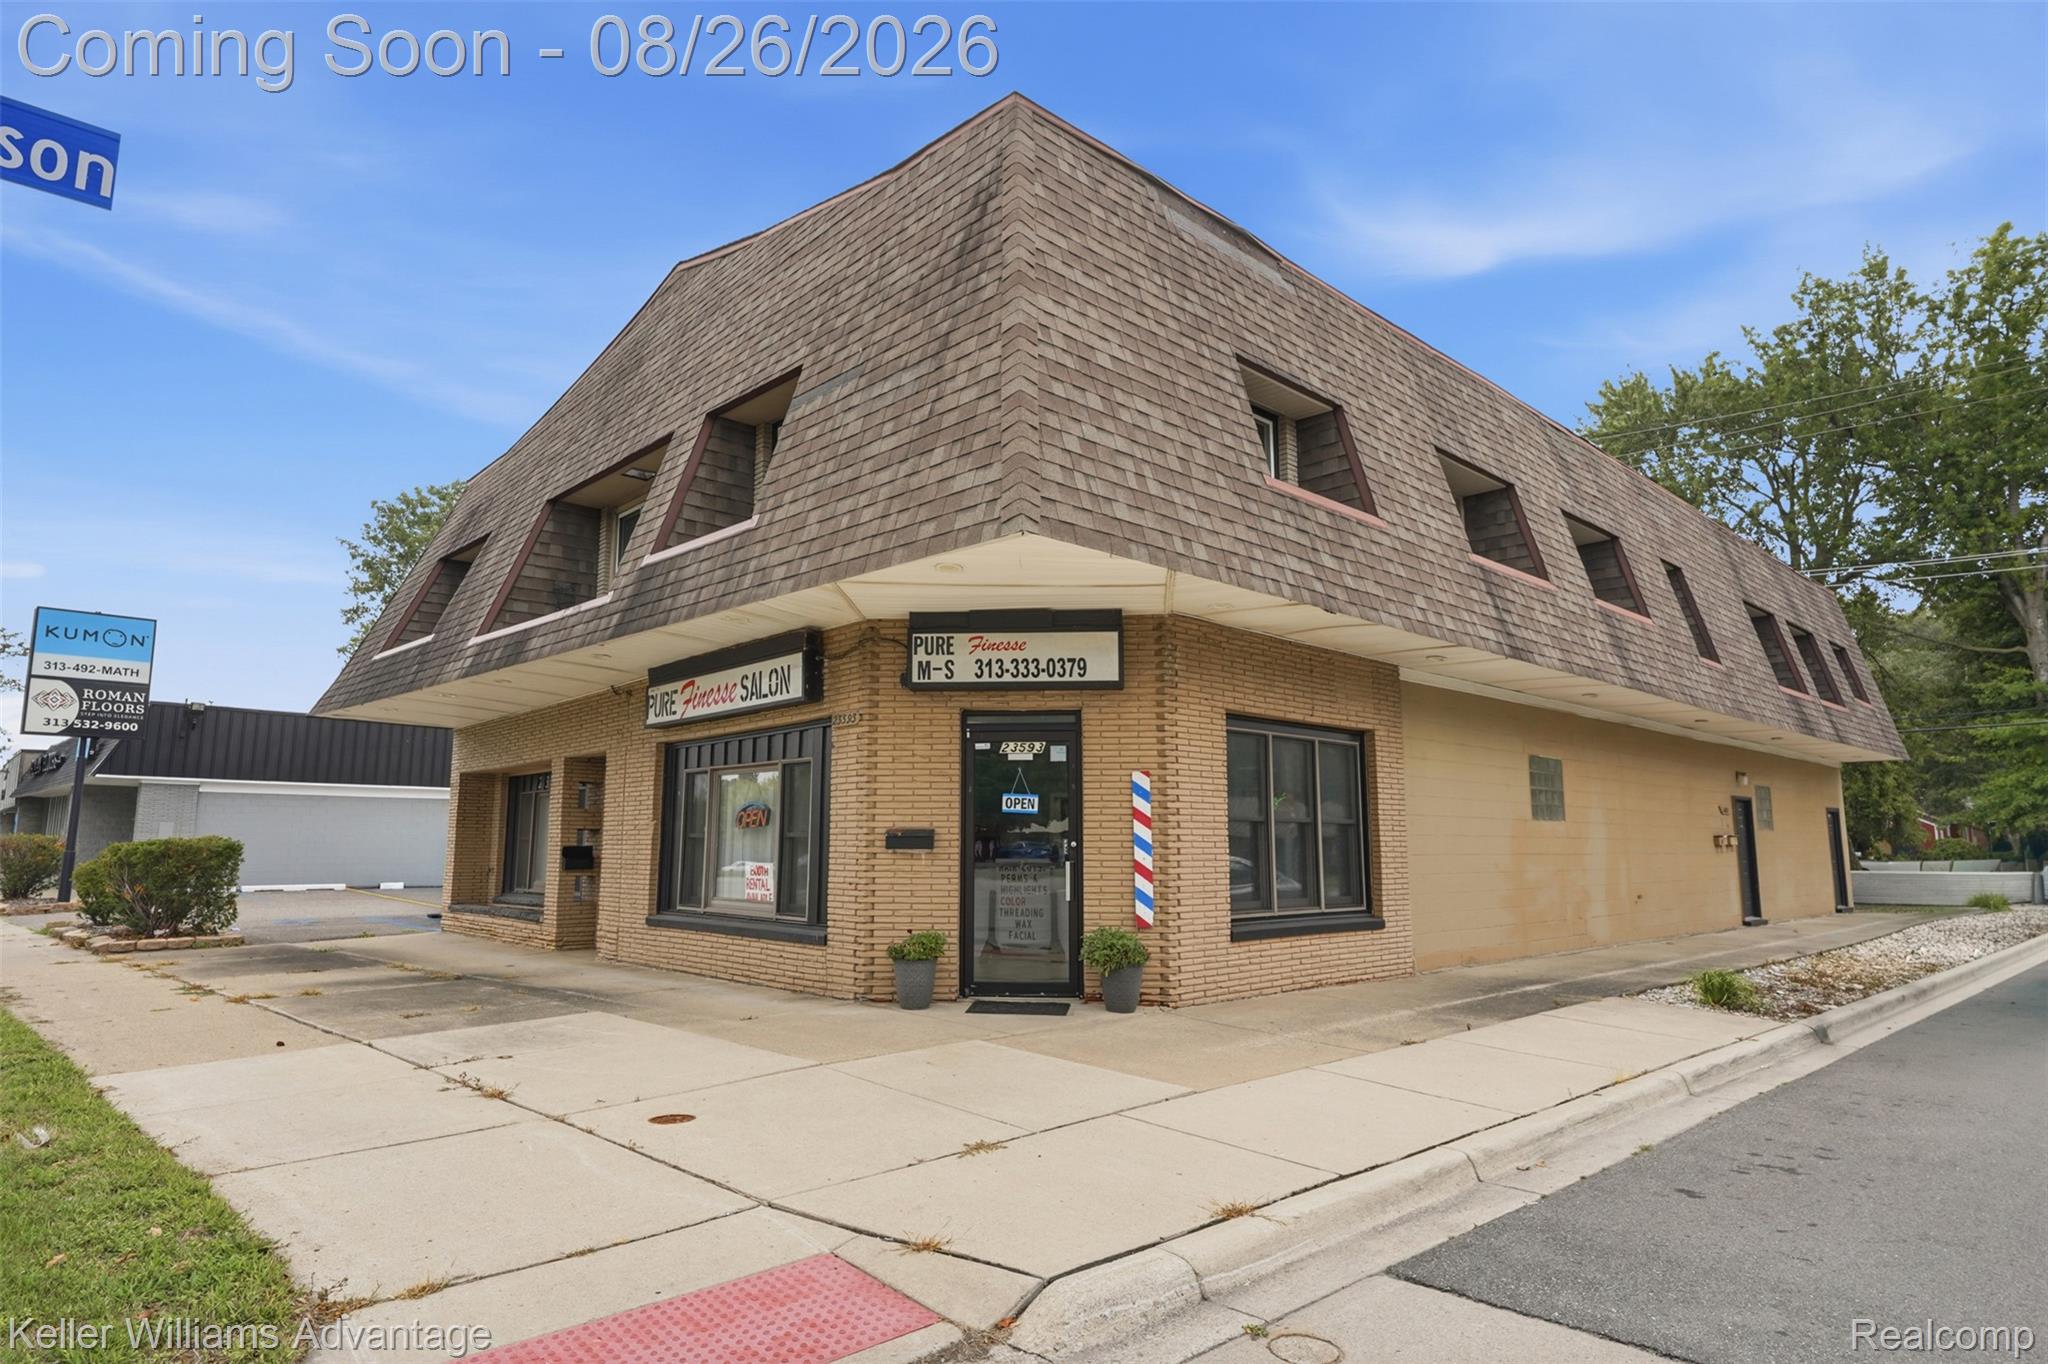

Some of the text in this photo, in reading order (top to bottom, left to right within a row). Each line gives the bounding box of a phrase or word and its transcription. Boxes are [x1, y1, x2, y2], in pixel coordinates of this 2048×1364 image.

[0, 126, 114, 198] son
[45, 625, 146, 648] KUMON
[913, 635, 1027, 656] PURE Finesse
[44, 660, 140, 677] 313-492-MATH
[917, 657, 1088, 680] M-S 313-333-0379
[82, 688, 147, 703] ROMAN
[649, 664, 791, 719] PURE Finesse SALON
[81, 700, 145, 714] FLOORS
[42, 717, 138, 732] 313 532-9600
[1001, 742, 1045, 753] 23593
[1005, 797, 1035, 809] OPEN
[736, 807, 768, 829] OPEN
[746, 878, 771, 892] RENTAL
[1001, 874, 1028, 883] PERMS
[1000, 896, 1026, 906] COLOR
[999, 907, 1045, 918] THREADING
[1015, 919, 1033, 929] WAX
[1008, 930, 1036, 941] FACIAL
